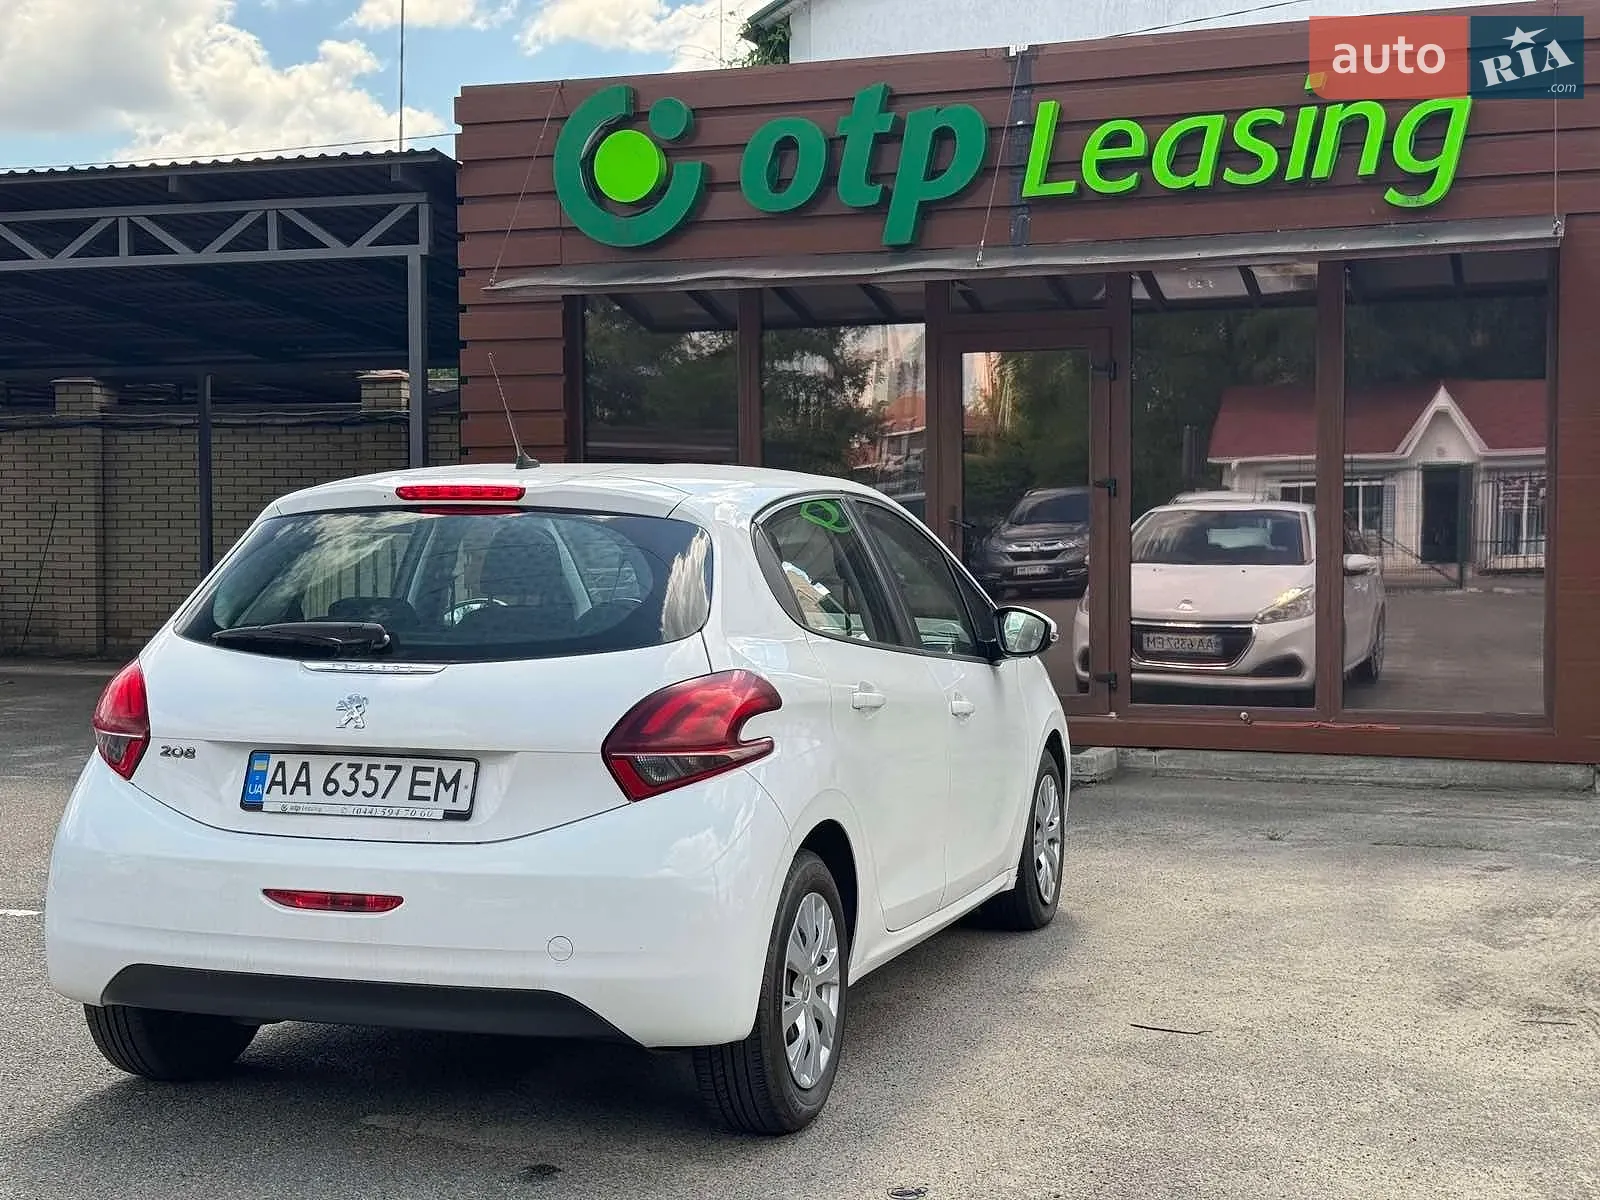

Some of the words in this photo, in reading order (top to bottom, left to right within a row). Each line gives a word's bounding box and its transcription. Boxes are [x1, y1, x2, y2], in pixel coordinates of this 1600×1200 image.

[740, 83, 988, 247] otp
[1021, 72, 1473, 208] Leasing
[159, 745, 197, 759] 208
[248, 783, 263, 795] UA
[266, 761, 312, 796] AA
[322, 762, 403, 799] 6357
[408, 766, 463, 803] EM
